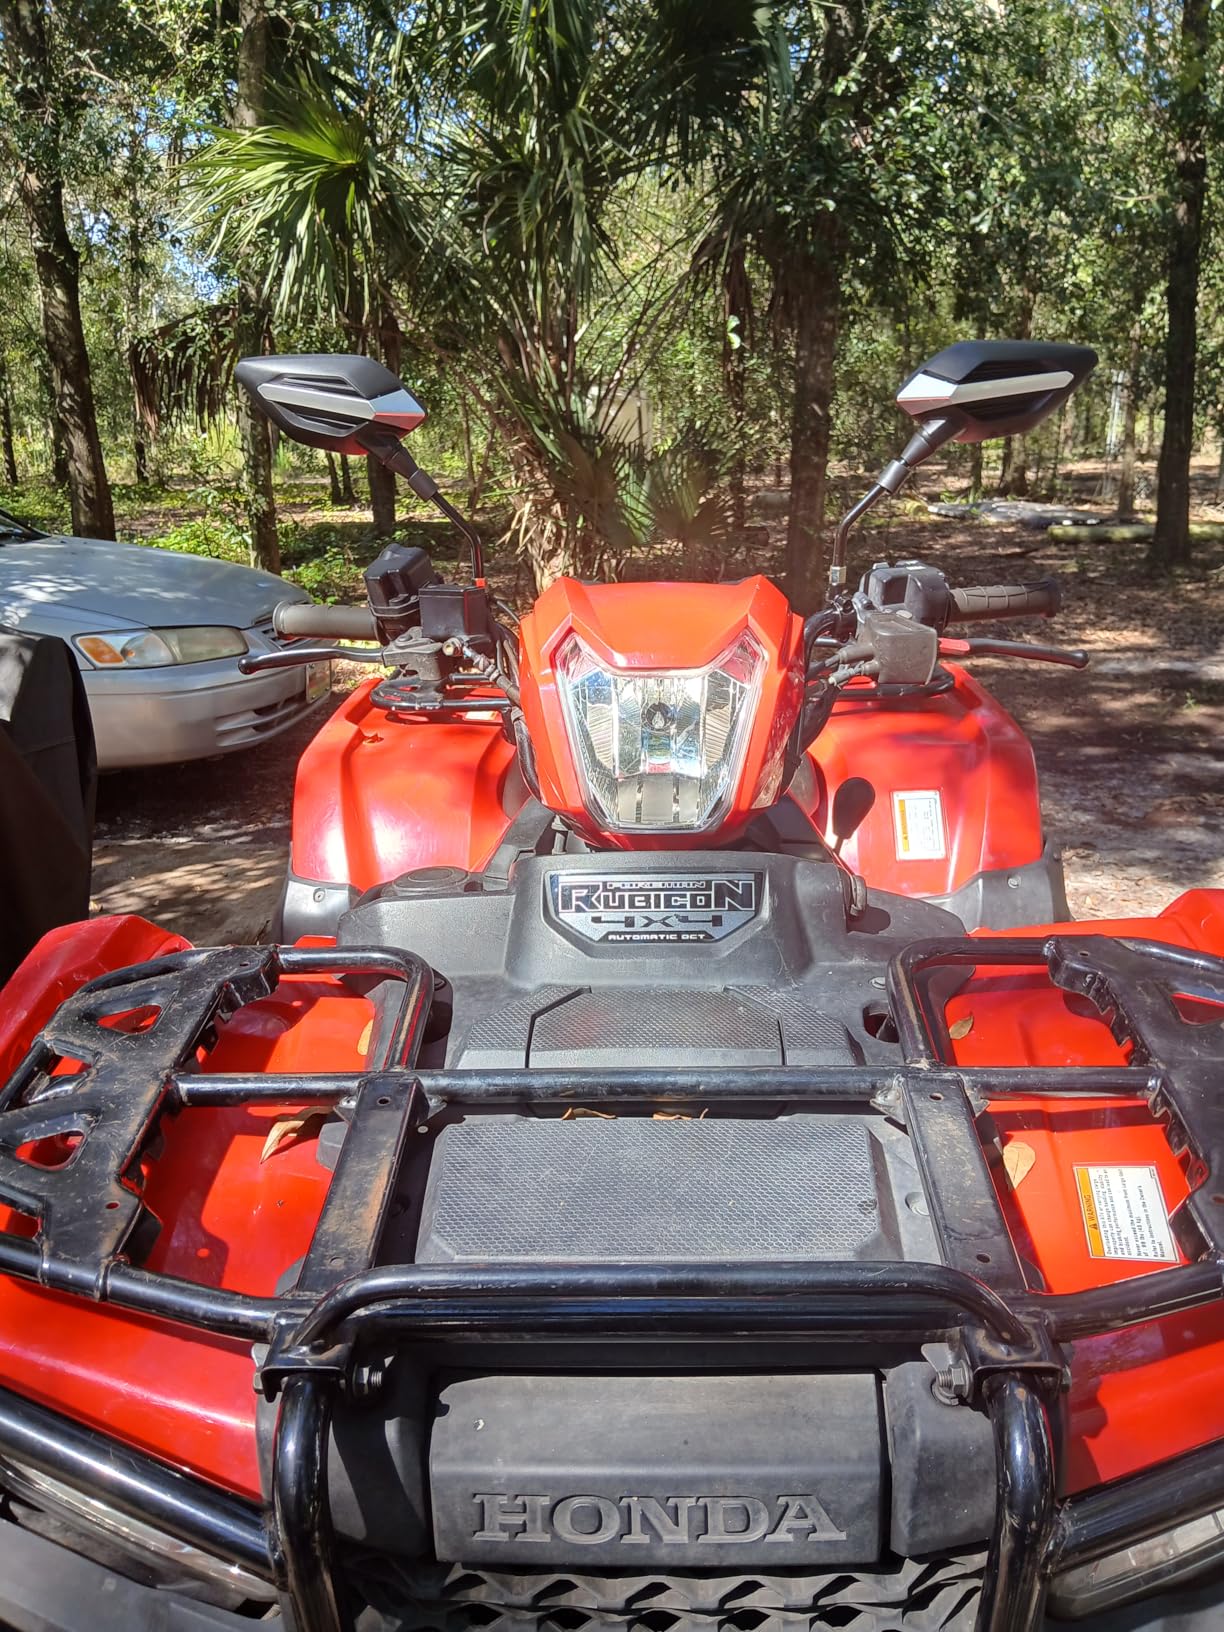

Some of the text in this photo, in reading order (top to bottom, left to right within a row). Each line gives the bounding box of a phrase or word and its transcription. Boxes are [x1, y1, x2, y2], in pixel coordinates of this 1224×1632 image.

[559, 881, 756, 912] RUBICON
[1084, 1194, 1095, 1221] WARNING
[472, 1494, 847, 1543] HONDA
